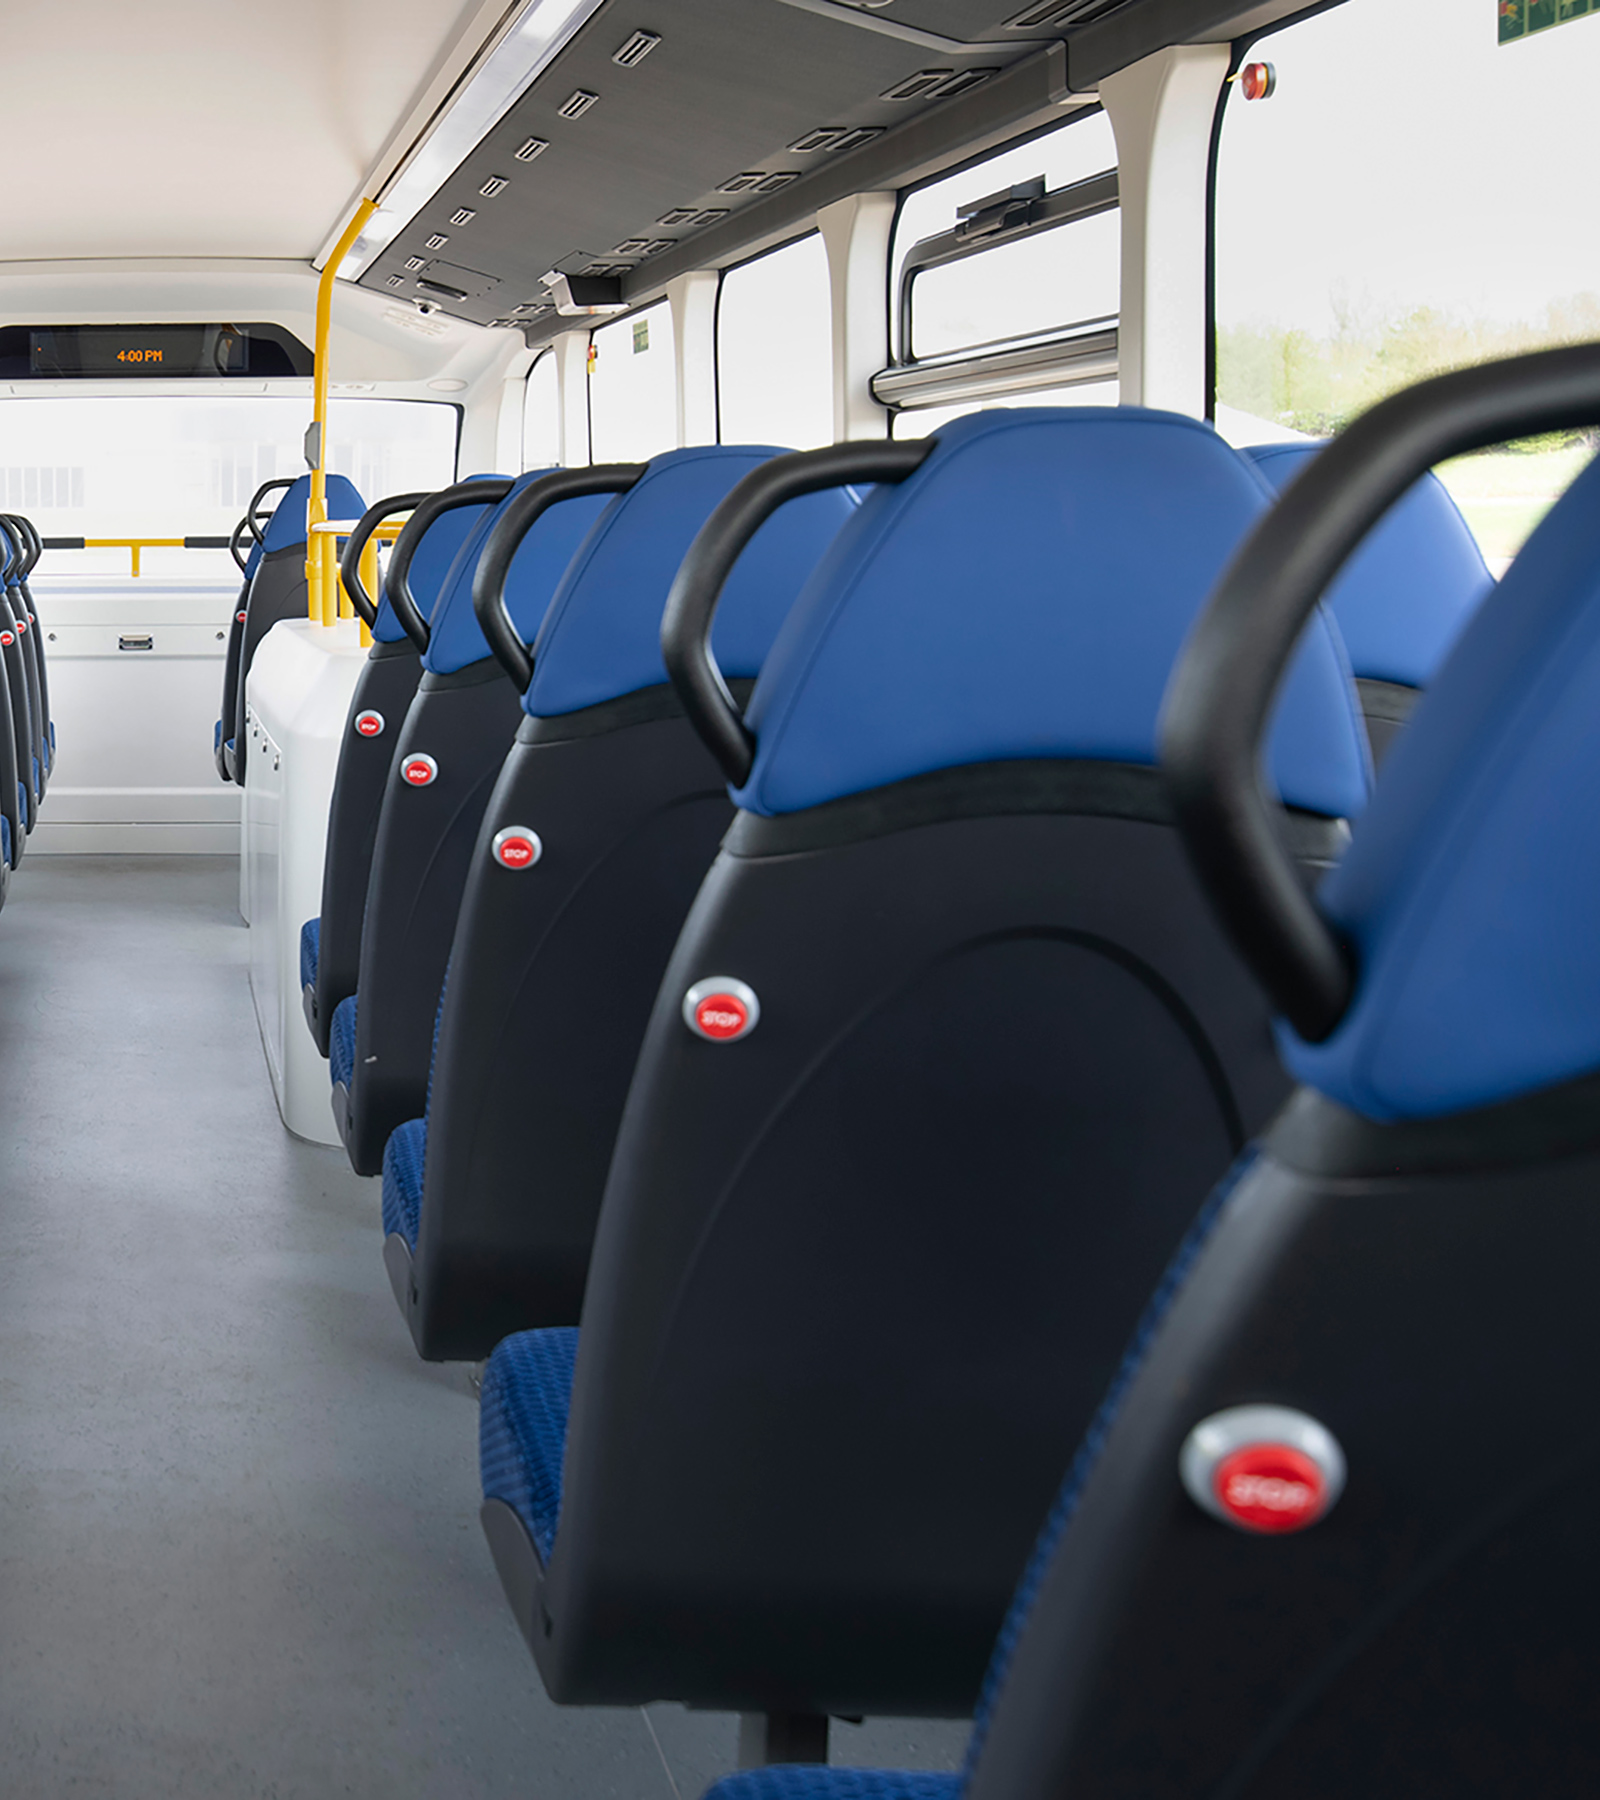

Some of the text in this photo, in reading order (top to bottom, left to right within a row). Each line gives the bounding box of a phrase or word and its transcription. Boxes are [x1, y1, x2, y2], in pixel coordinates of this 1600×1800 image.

[117, 350, 163, 362] 4:00 PM
[408, 769, 428, 779] STOP
[503, 848, 529, 859] STOP
[701, 1010, 741, 1028] STOP
[1226, 1473, 1311, 1512] STOP
